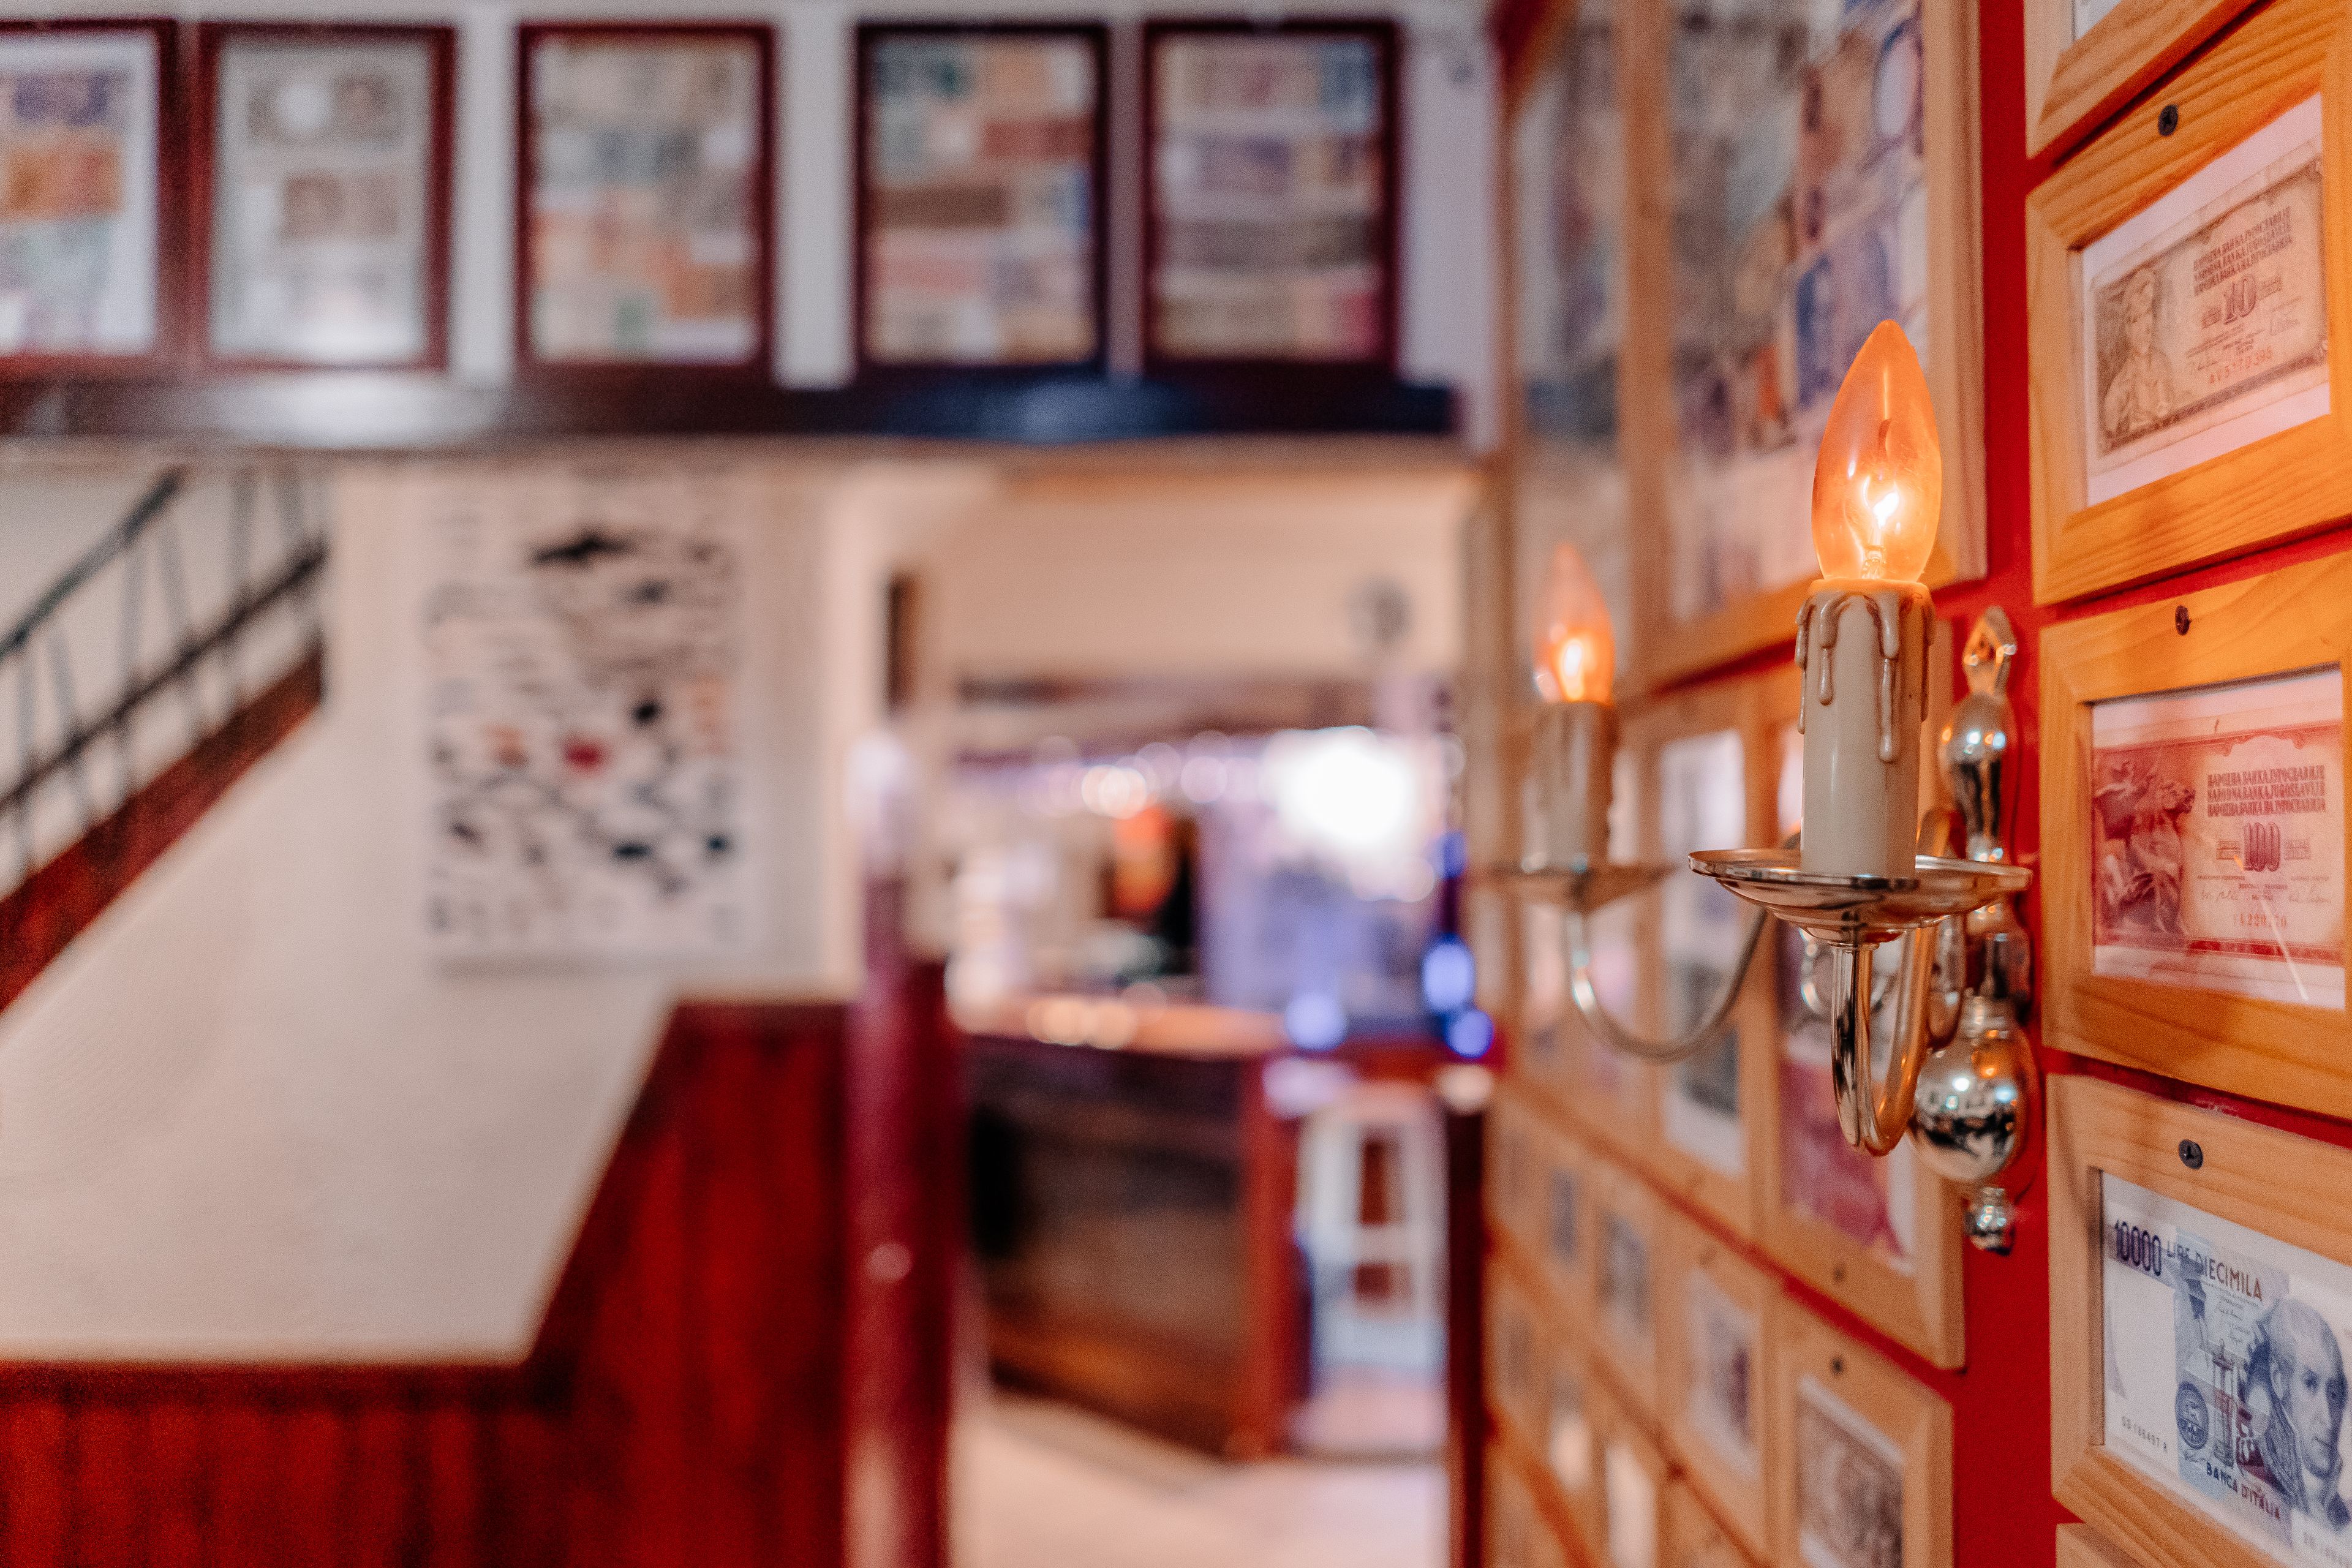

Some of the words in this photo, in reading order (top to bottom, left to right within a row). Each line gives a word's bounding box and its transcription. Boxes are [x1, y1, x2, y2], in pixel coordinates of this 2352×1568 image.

[2224, 273, 2256, 325] 10
[2243, 822, 2280, 872] 100
[2115, 1219, 2162, 1276] 10000
[2195, 1251, 2263, 1302] DIECIMILA
[2206, 1461, 2238, 1493] BANCA
